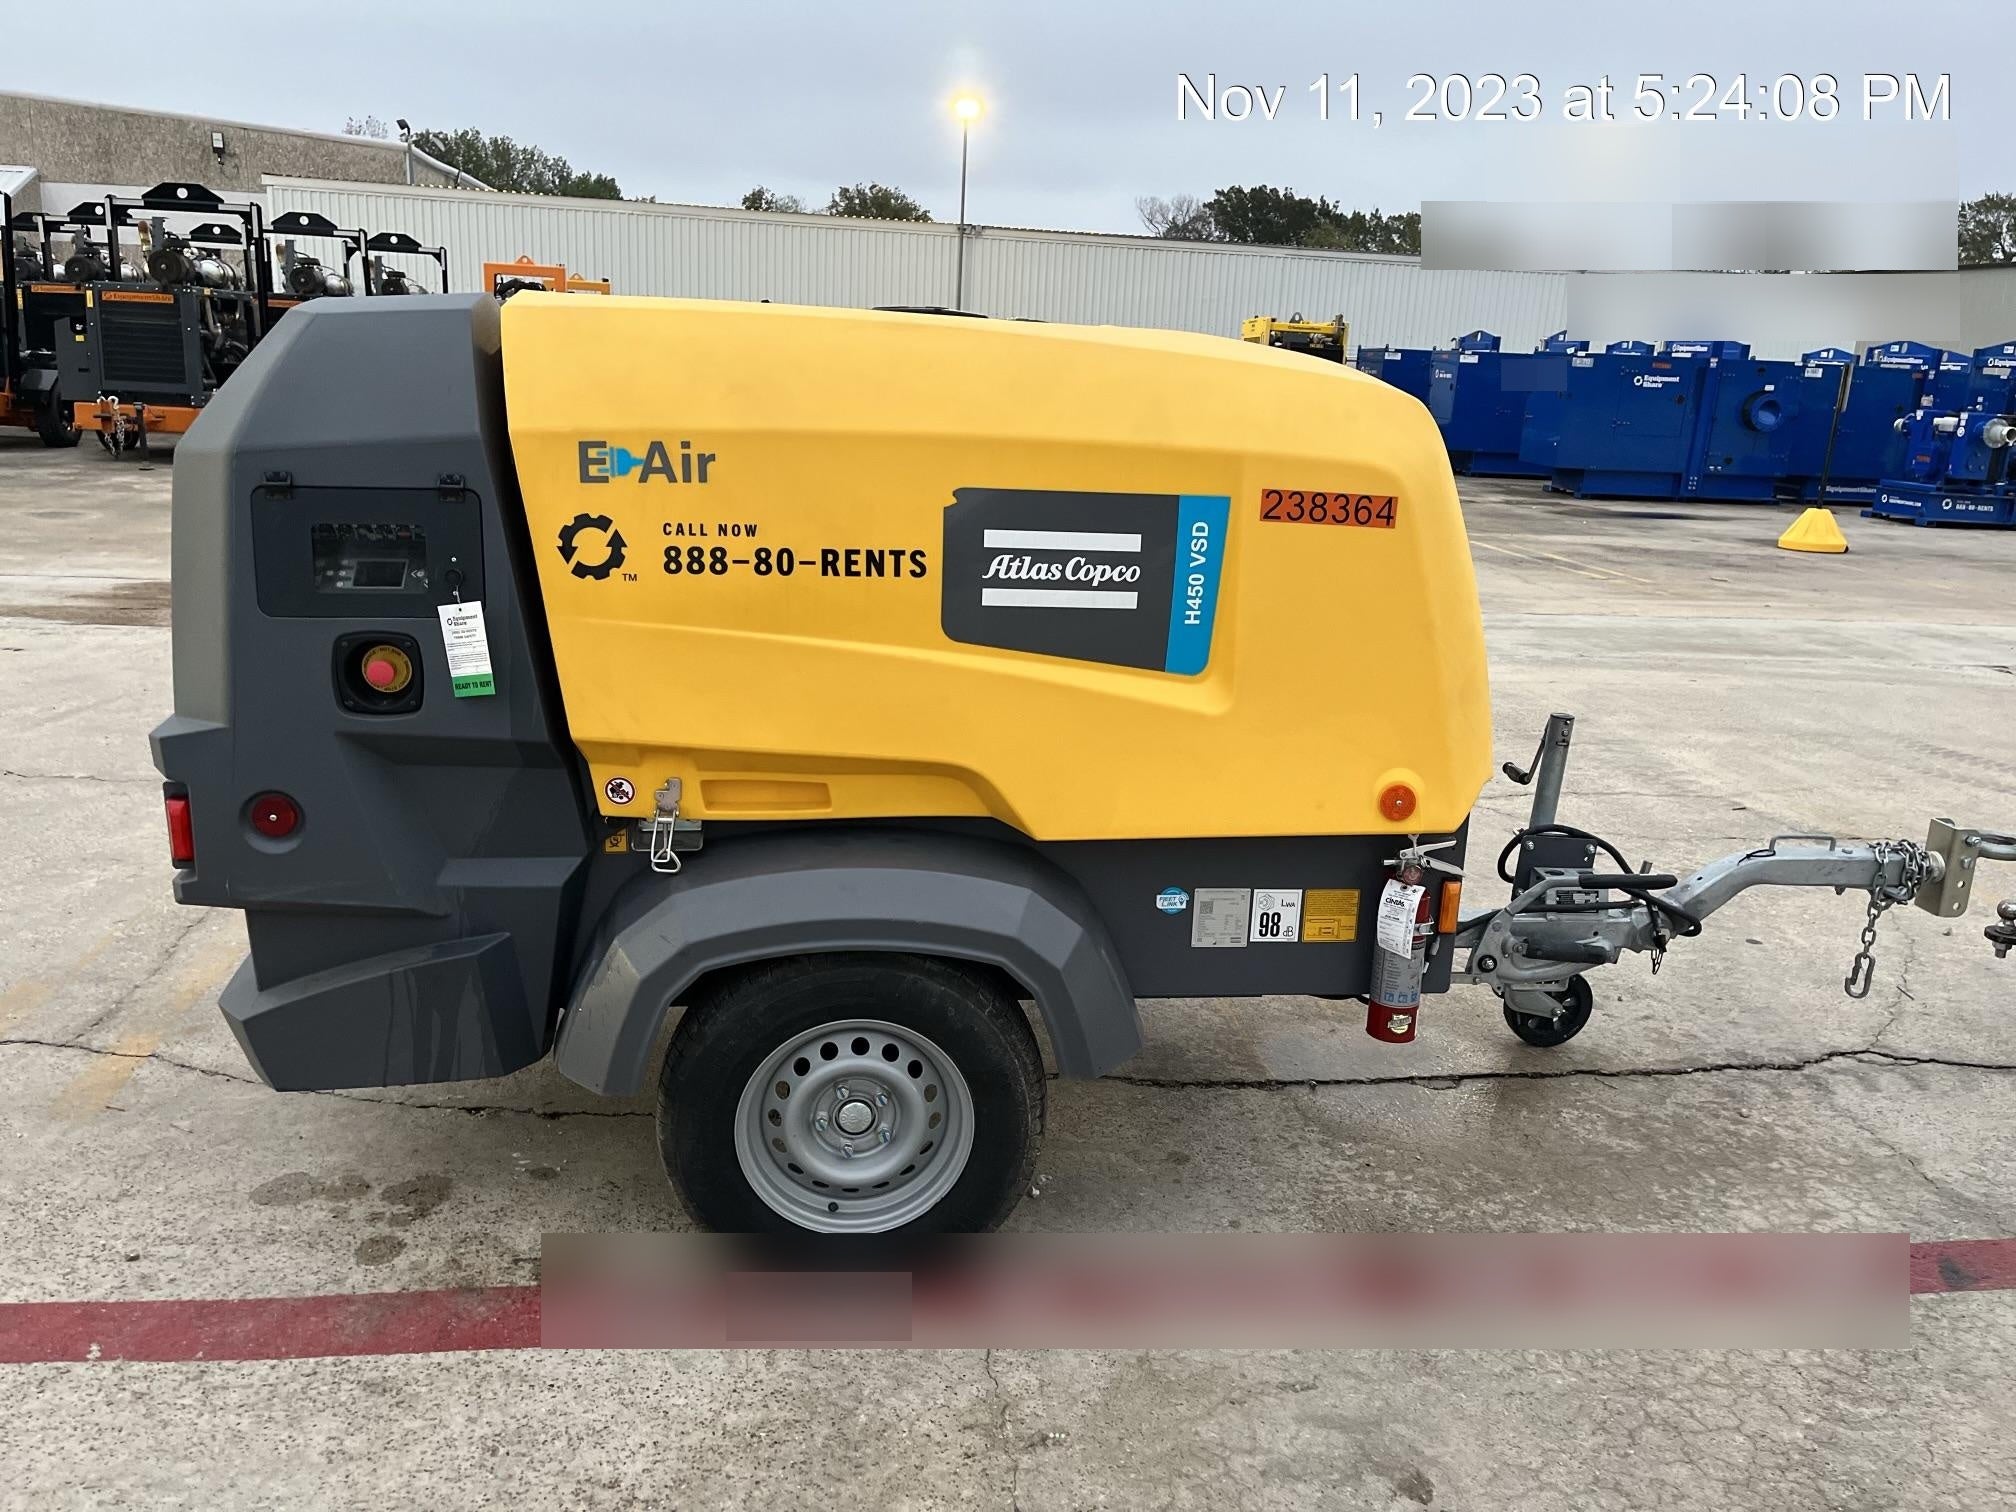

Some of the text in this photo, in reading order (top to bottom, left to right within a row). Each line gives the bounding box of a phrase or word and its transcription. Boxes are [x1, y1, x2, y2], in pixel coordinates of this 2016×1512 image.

[1643, 374, 1680, 384] Equipment
[1262, 489, 1396, 527] 238364
[662, 523, 758, 538] CALL NOW
[662, 545, 927, 579] 888-80-RENTS
[1184, 520, 1210, 626] H450 VSD
[479, 680, 492, 688] RENT
[1258, 911, 1282, 937] 98
[1282, 926, 1294, 937] dB
